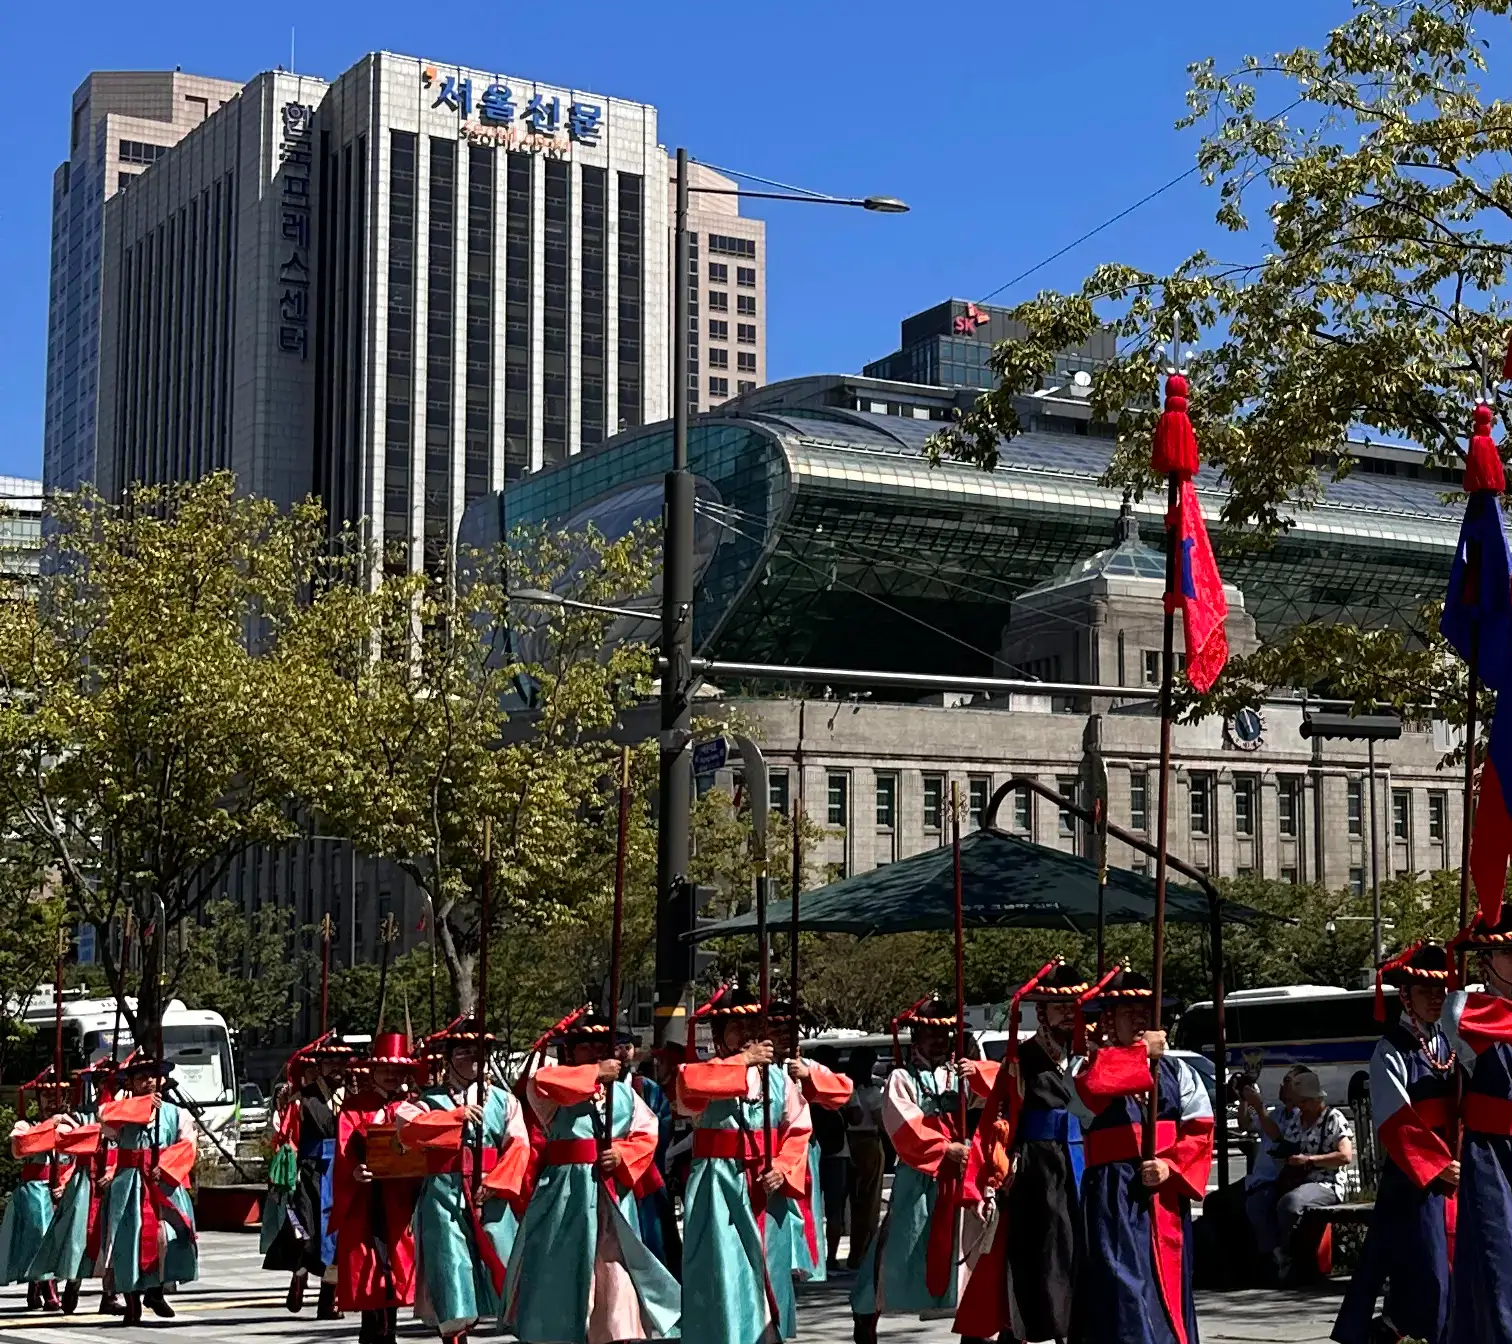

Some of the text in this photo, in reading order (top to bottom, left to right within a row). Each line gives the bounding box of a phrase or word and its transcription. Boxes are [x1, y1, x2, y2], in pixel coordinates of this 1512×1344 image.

[433, 75, 605, 145] 서울신문
[279, 102, 314, 361] 한국프레스센터
[954, 315, 977, 335] SK
